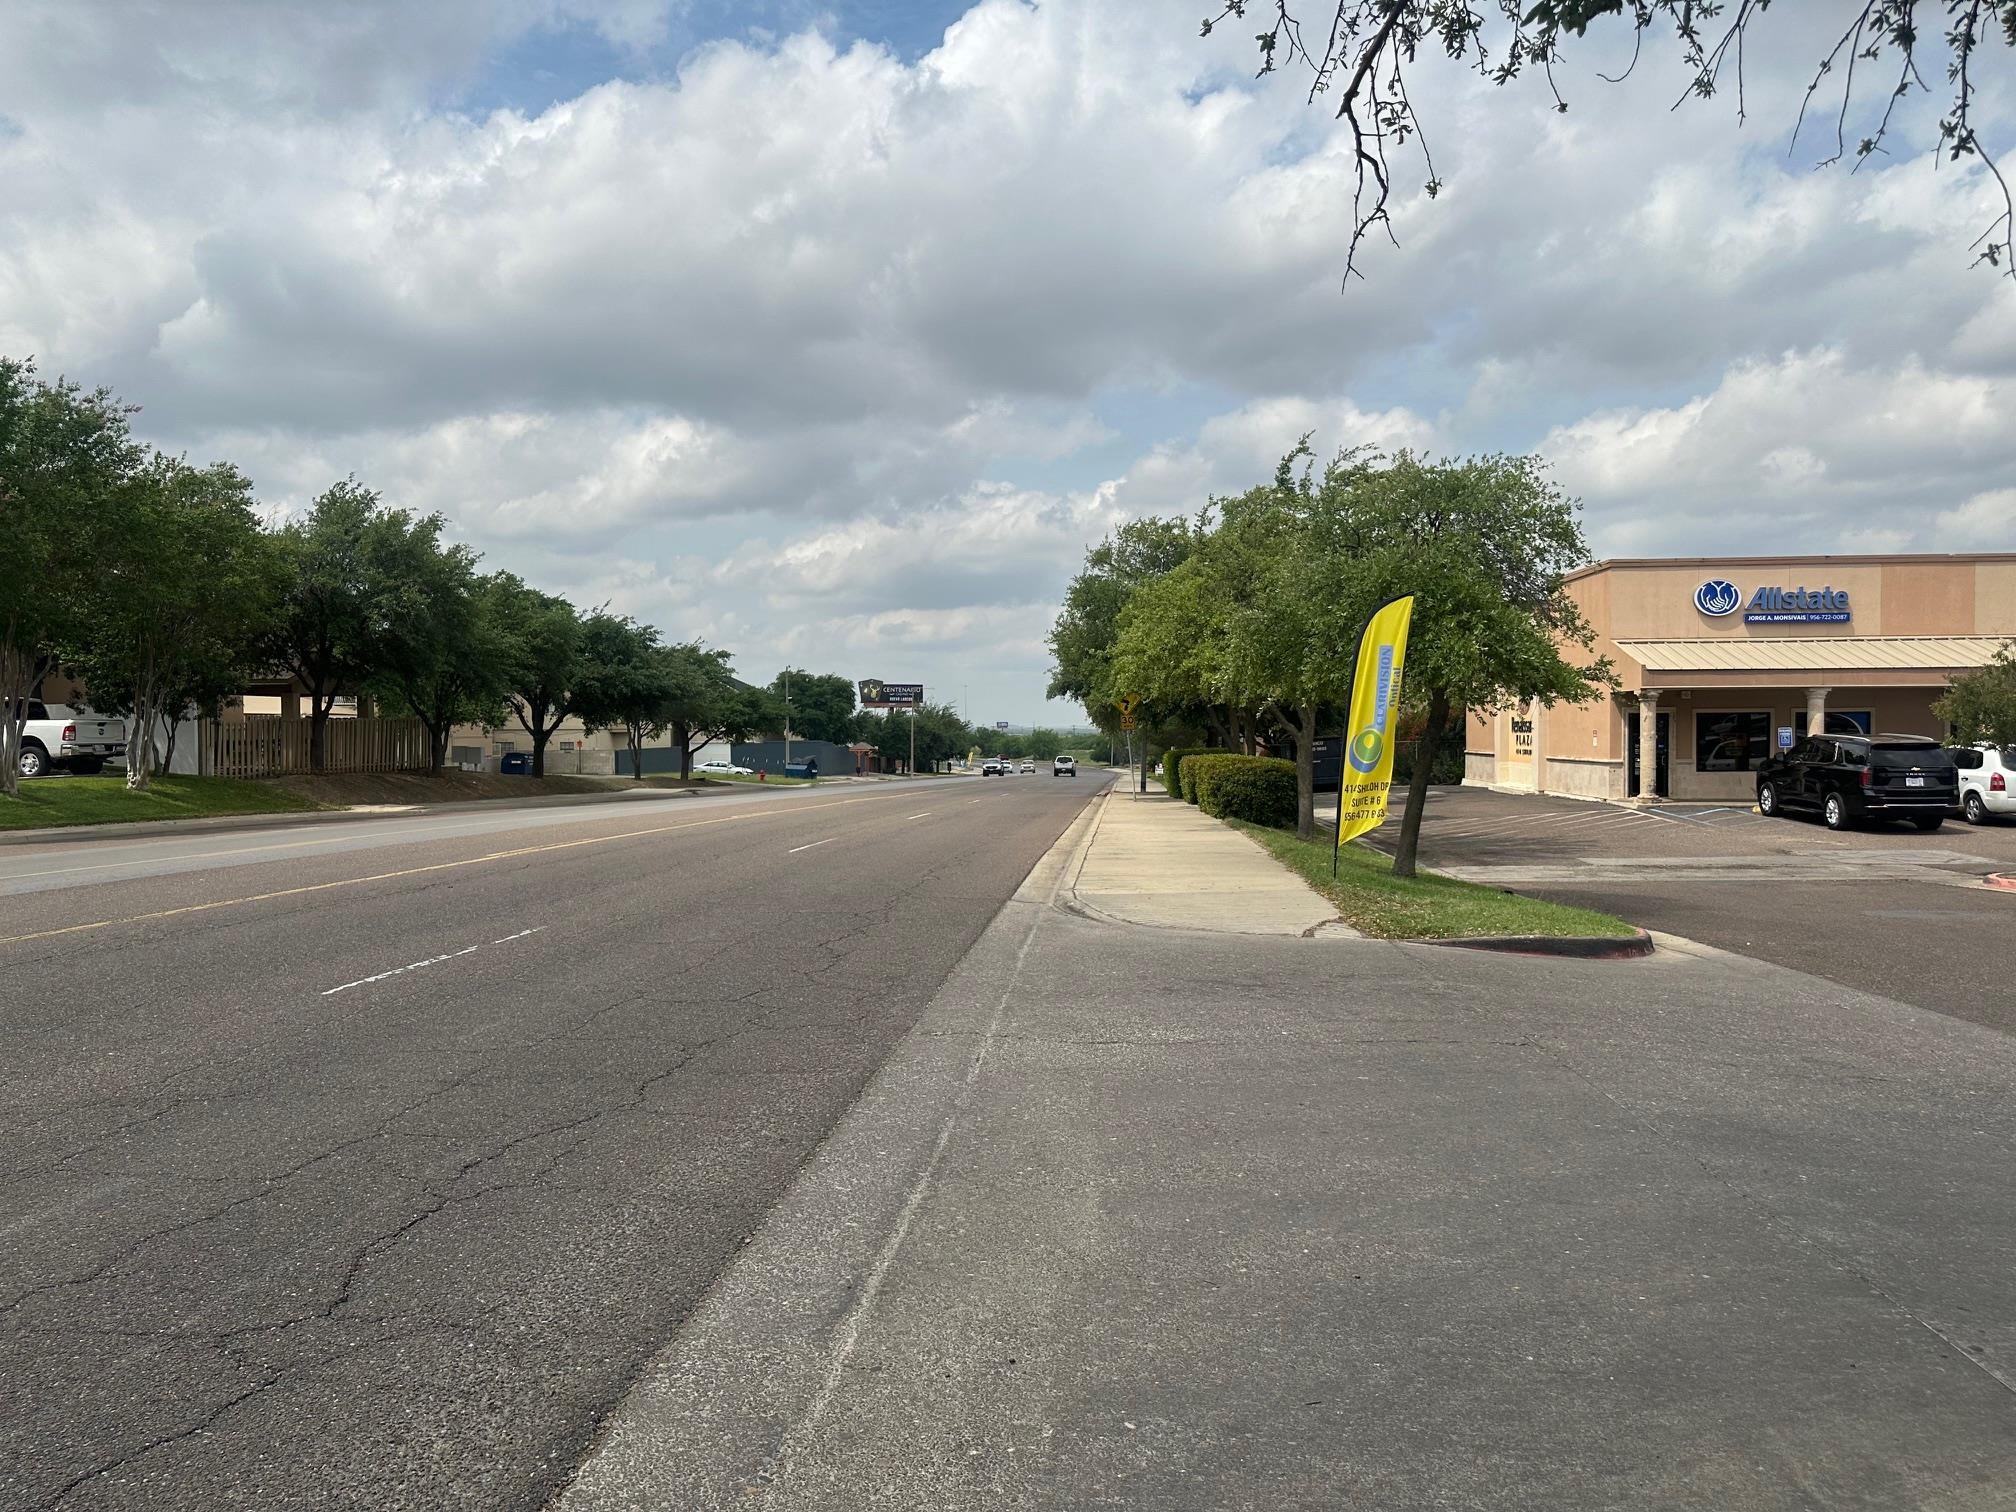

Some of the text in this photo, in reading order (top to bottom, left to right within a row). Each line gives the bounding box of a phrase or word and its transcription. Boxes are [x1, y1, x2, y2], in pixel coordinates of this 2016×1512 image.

[1744, 586, 1849, 610] Allstate
[1376, 648, 1391, 726] CLARIVISION
[1121, 716, 1134, 724] 30
